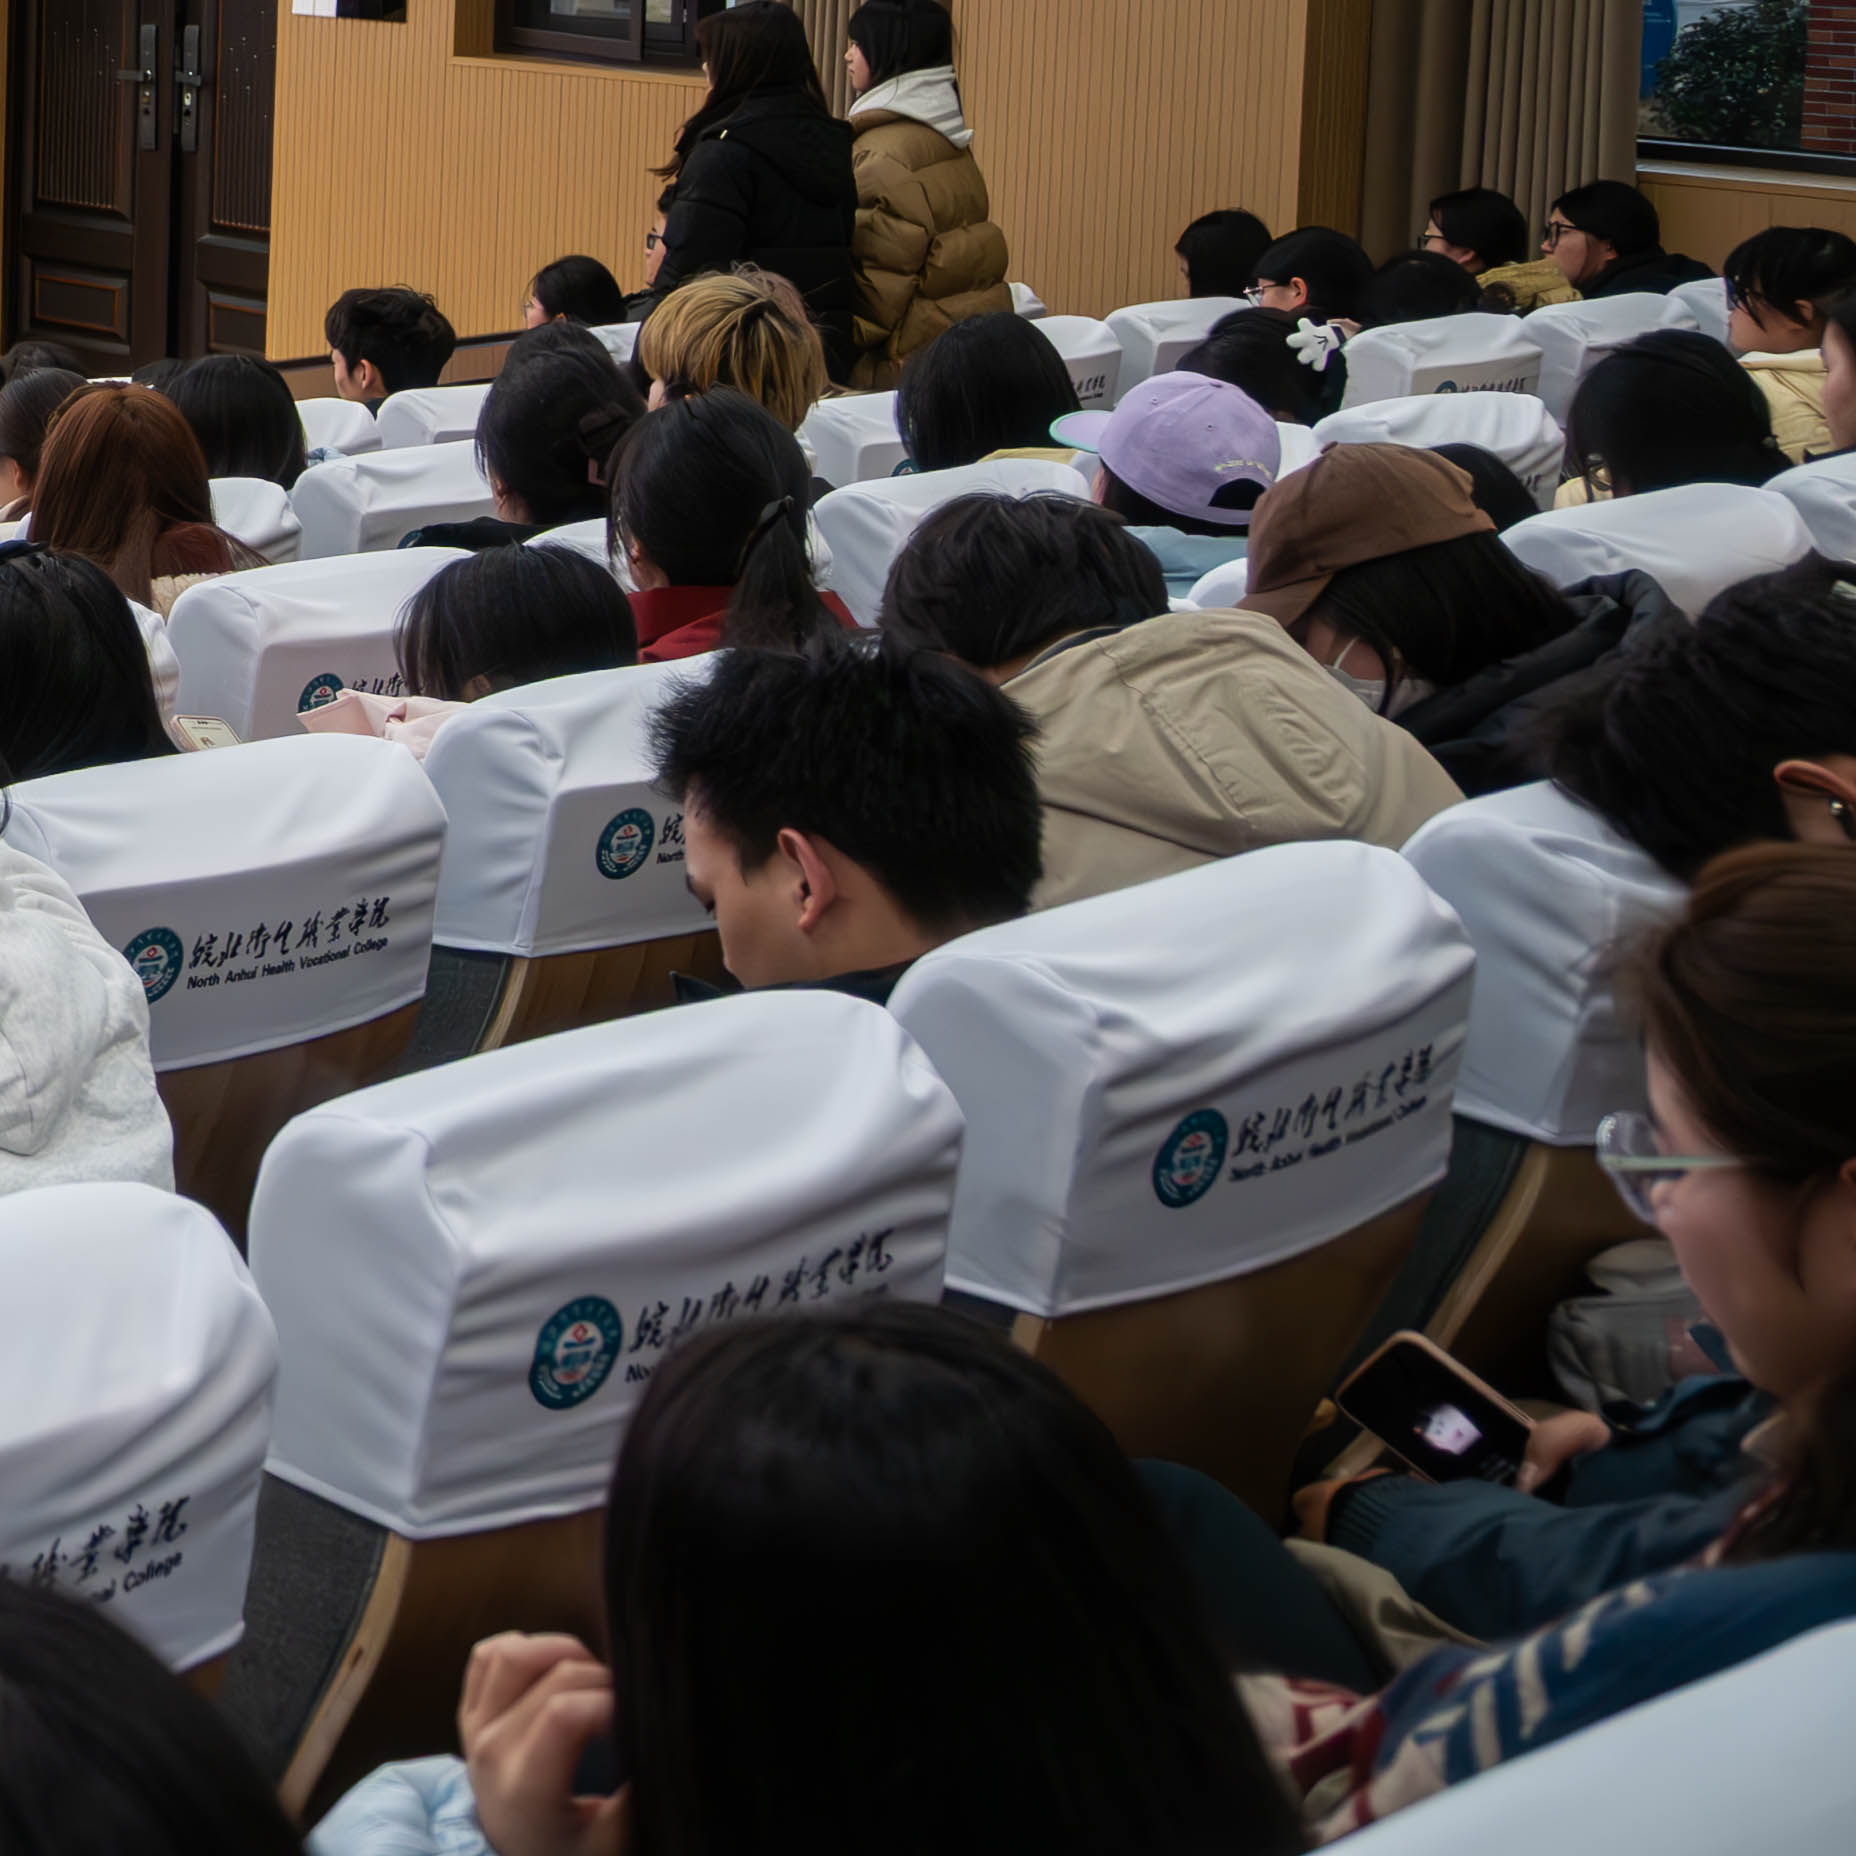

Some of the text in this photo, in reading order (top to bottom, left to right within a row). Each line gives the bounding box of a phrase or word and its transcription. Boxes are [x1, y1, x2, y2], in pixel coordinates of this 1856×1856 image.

[186, 936, 389, 990] North Anhui Health Vocational College
